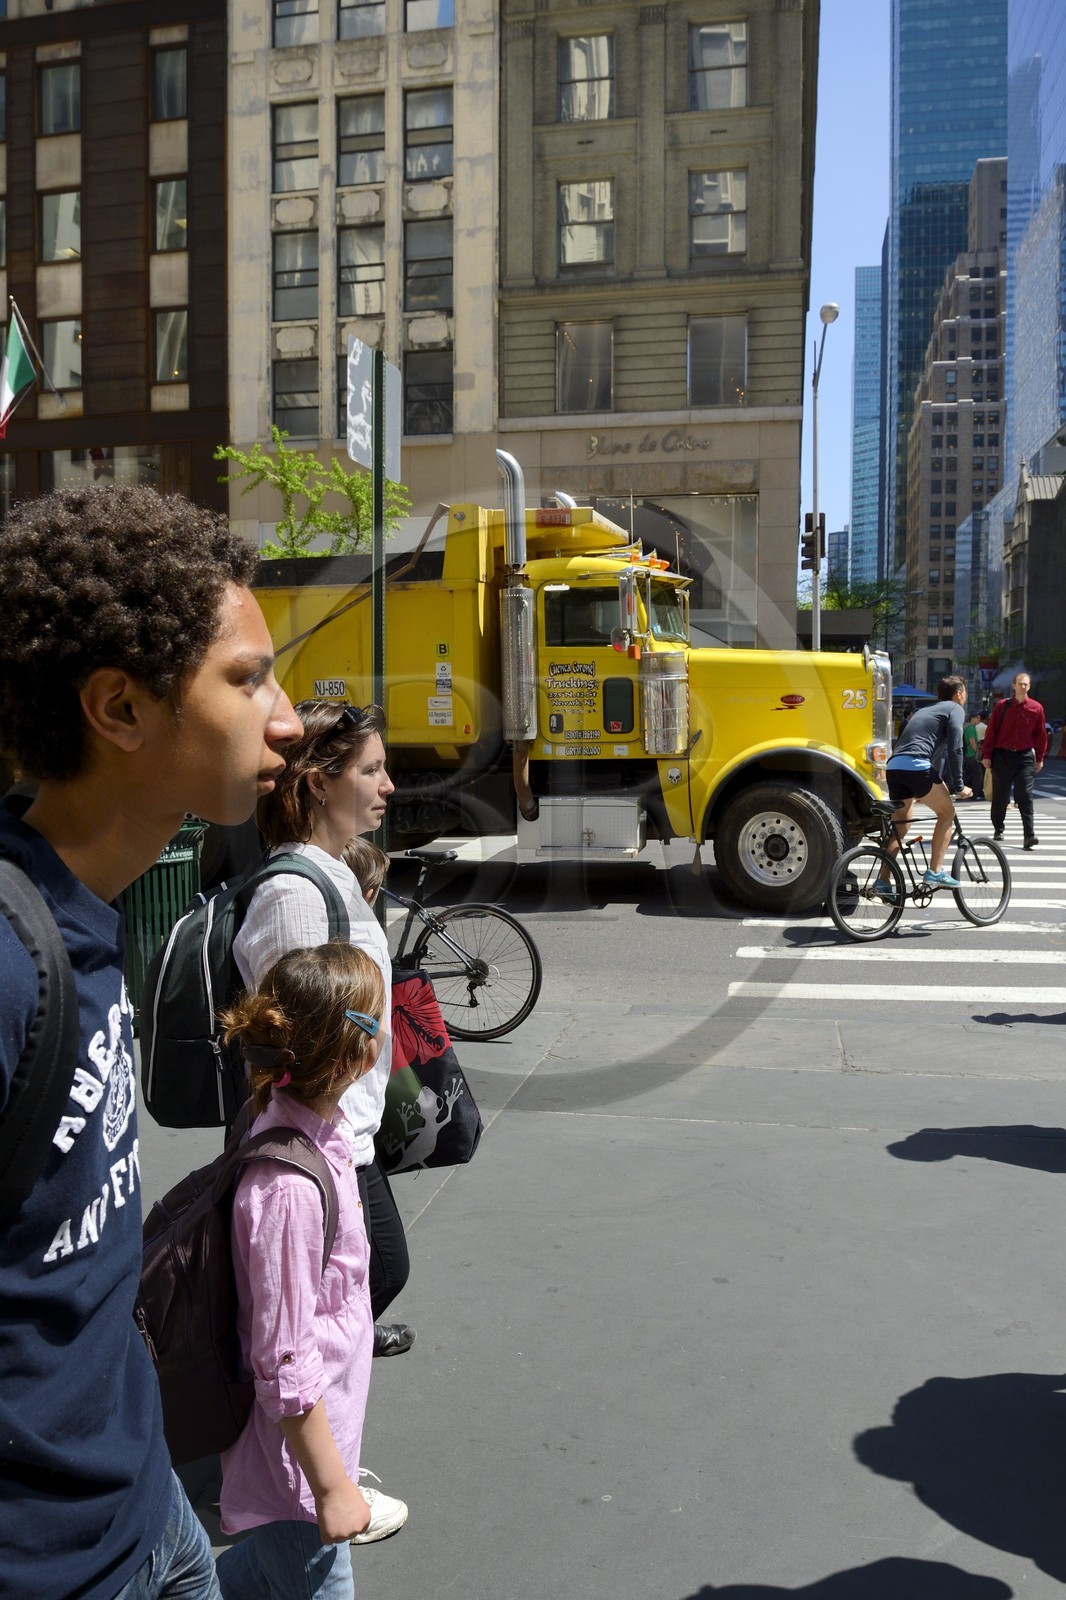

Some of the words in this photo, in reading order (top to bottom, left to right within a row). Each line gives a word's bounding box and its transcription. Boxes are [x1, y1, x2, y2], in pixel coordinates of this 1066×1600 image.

[638, 432, 657, 454] de
[439, 644, 447, 654] B
[314, 681, 345, 696] NJ-850
[545, 677, 595, 690] Trucking
[841, 689, 868, 709] 25
